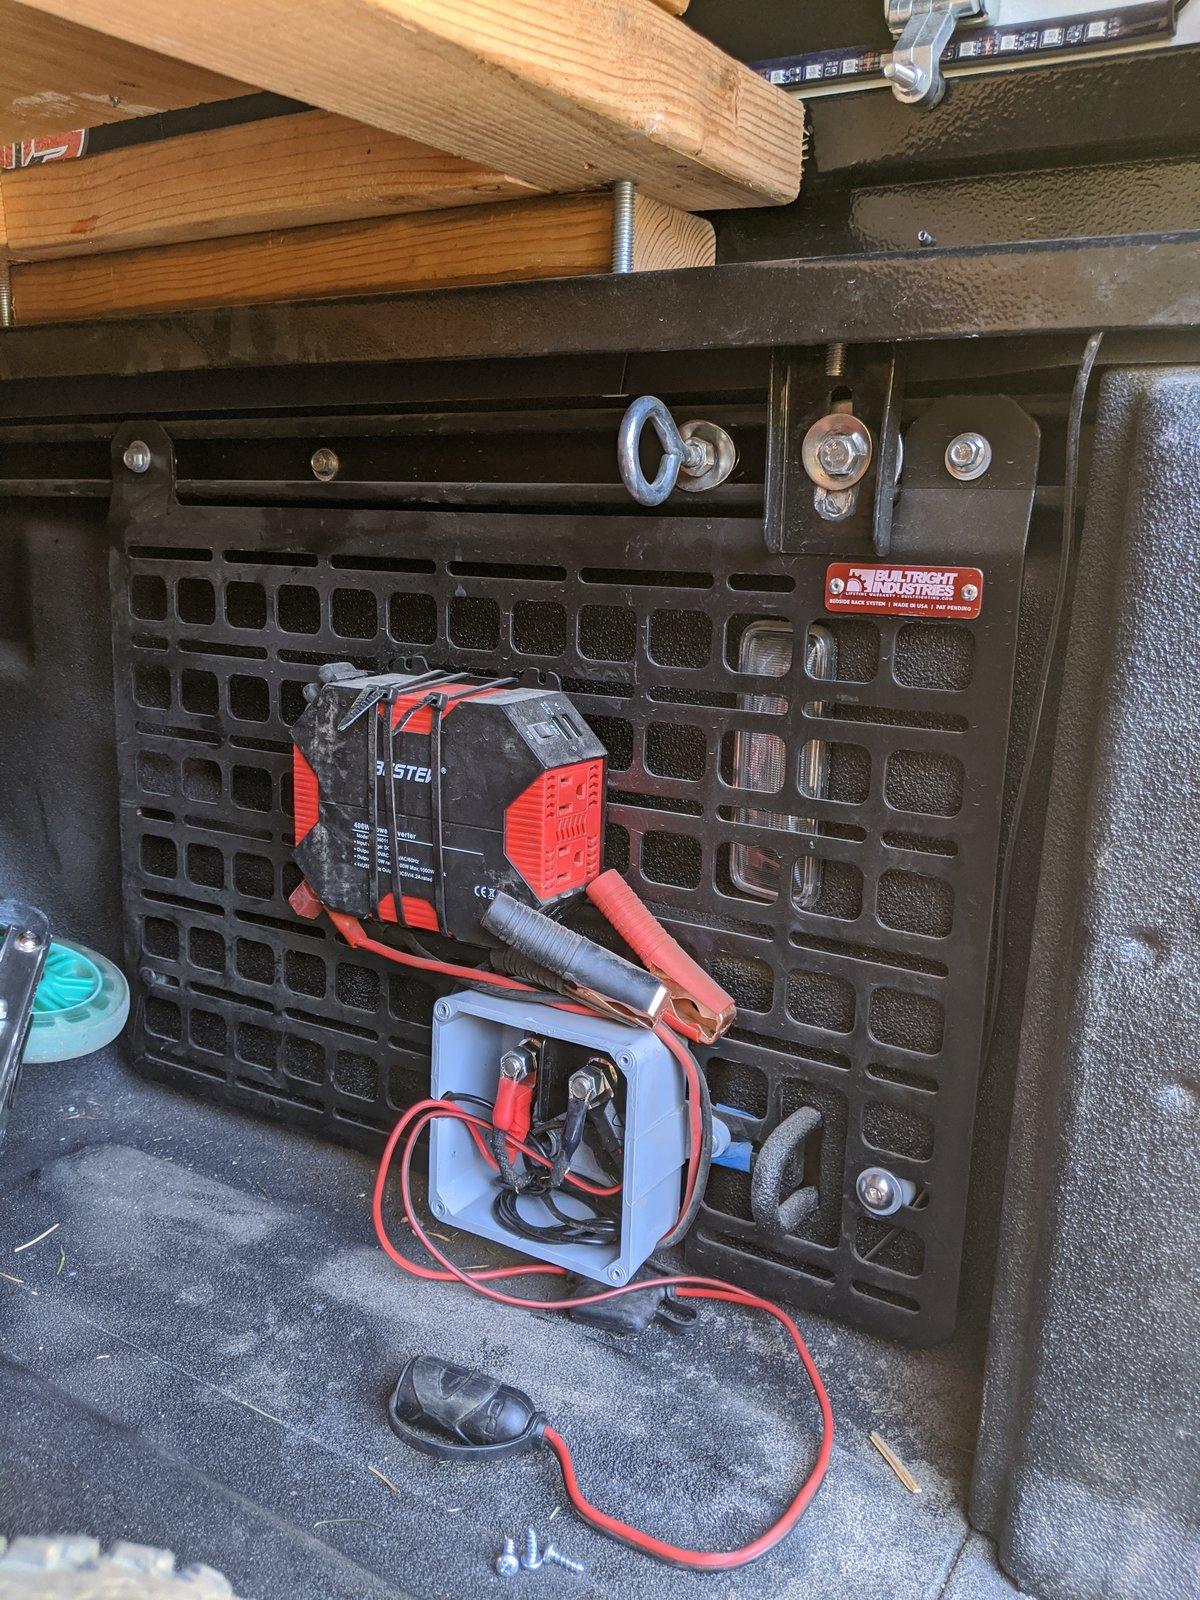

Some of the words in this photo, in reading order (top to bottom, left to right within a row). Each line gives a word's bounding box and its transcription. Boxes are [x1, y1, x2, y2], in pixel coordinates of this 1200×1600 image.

[875, 569, 959, 585] BUILTRIGHT
[873, 580, 955, 597] INDUSTRIES
[946, 604, 972, 612] PENDING
